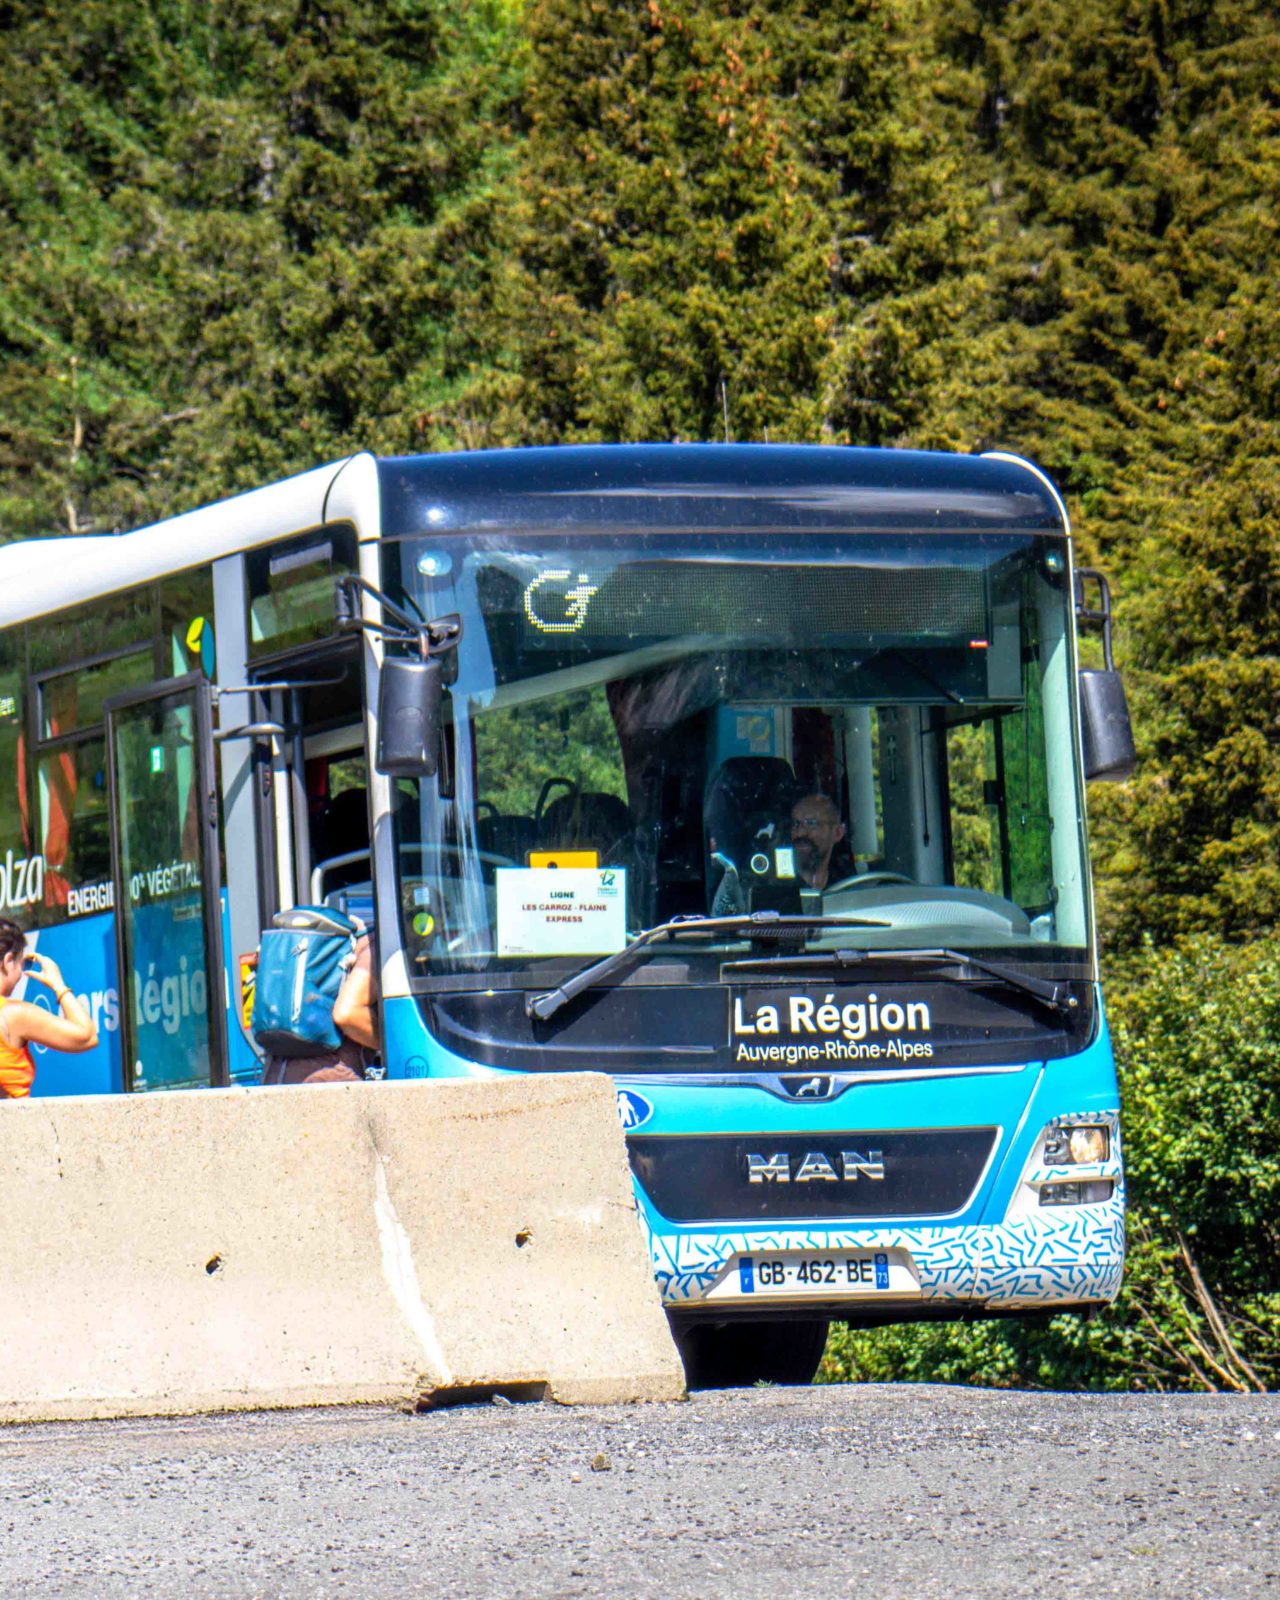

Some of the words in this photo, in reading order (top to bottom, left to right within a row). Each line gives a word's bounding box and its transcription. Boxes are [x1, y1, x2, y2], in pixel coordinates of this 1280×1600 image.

[521, 903, 537, 912] LES
[538, 903, 573, 912] CARROZ
[578, 903, 608, 912] FLAINE
[549, 891, 576, 899] LIGNE
[545, 915, 583, 923] EXPRESS
[733, 997, 780, 1034] La
[788, 993, 932, 1040] Région
[736, 1038, 934, 1065] Auvergne-Rhône-Alpes
[746, 1150, 885, 1183] MAN
[758, 1258, 874, 1285] GB-462-BE
[877, 1272, 888, 1284] 73
